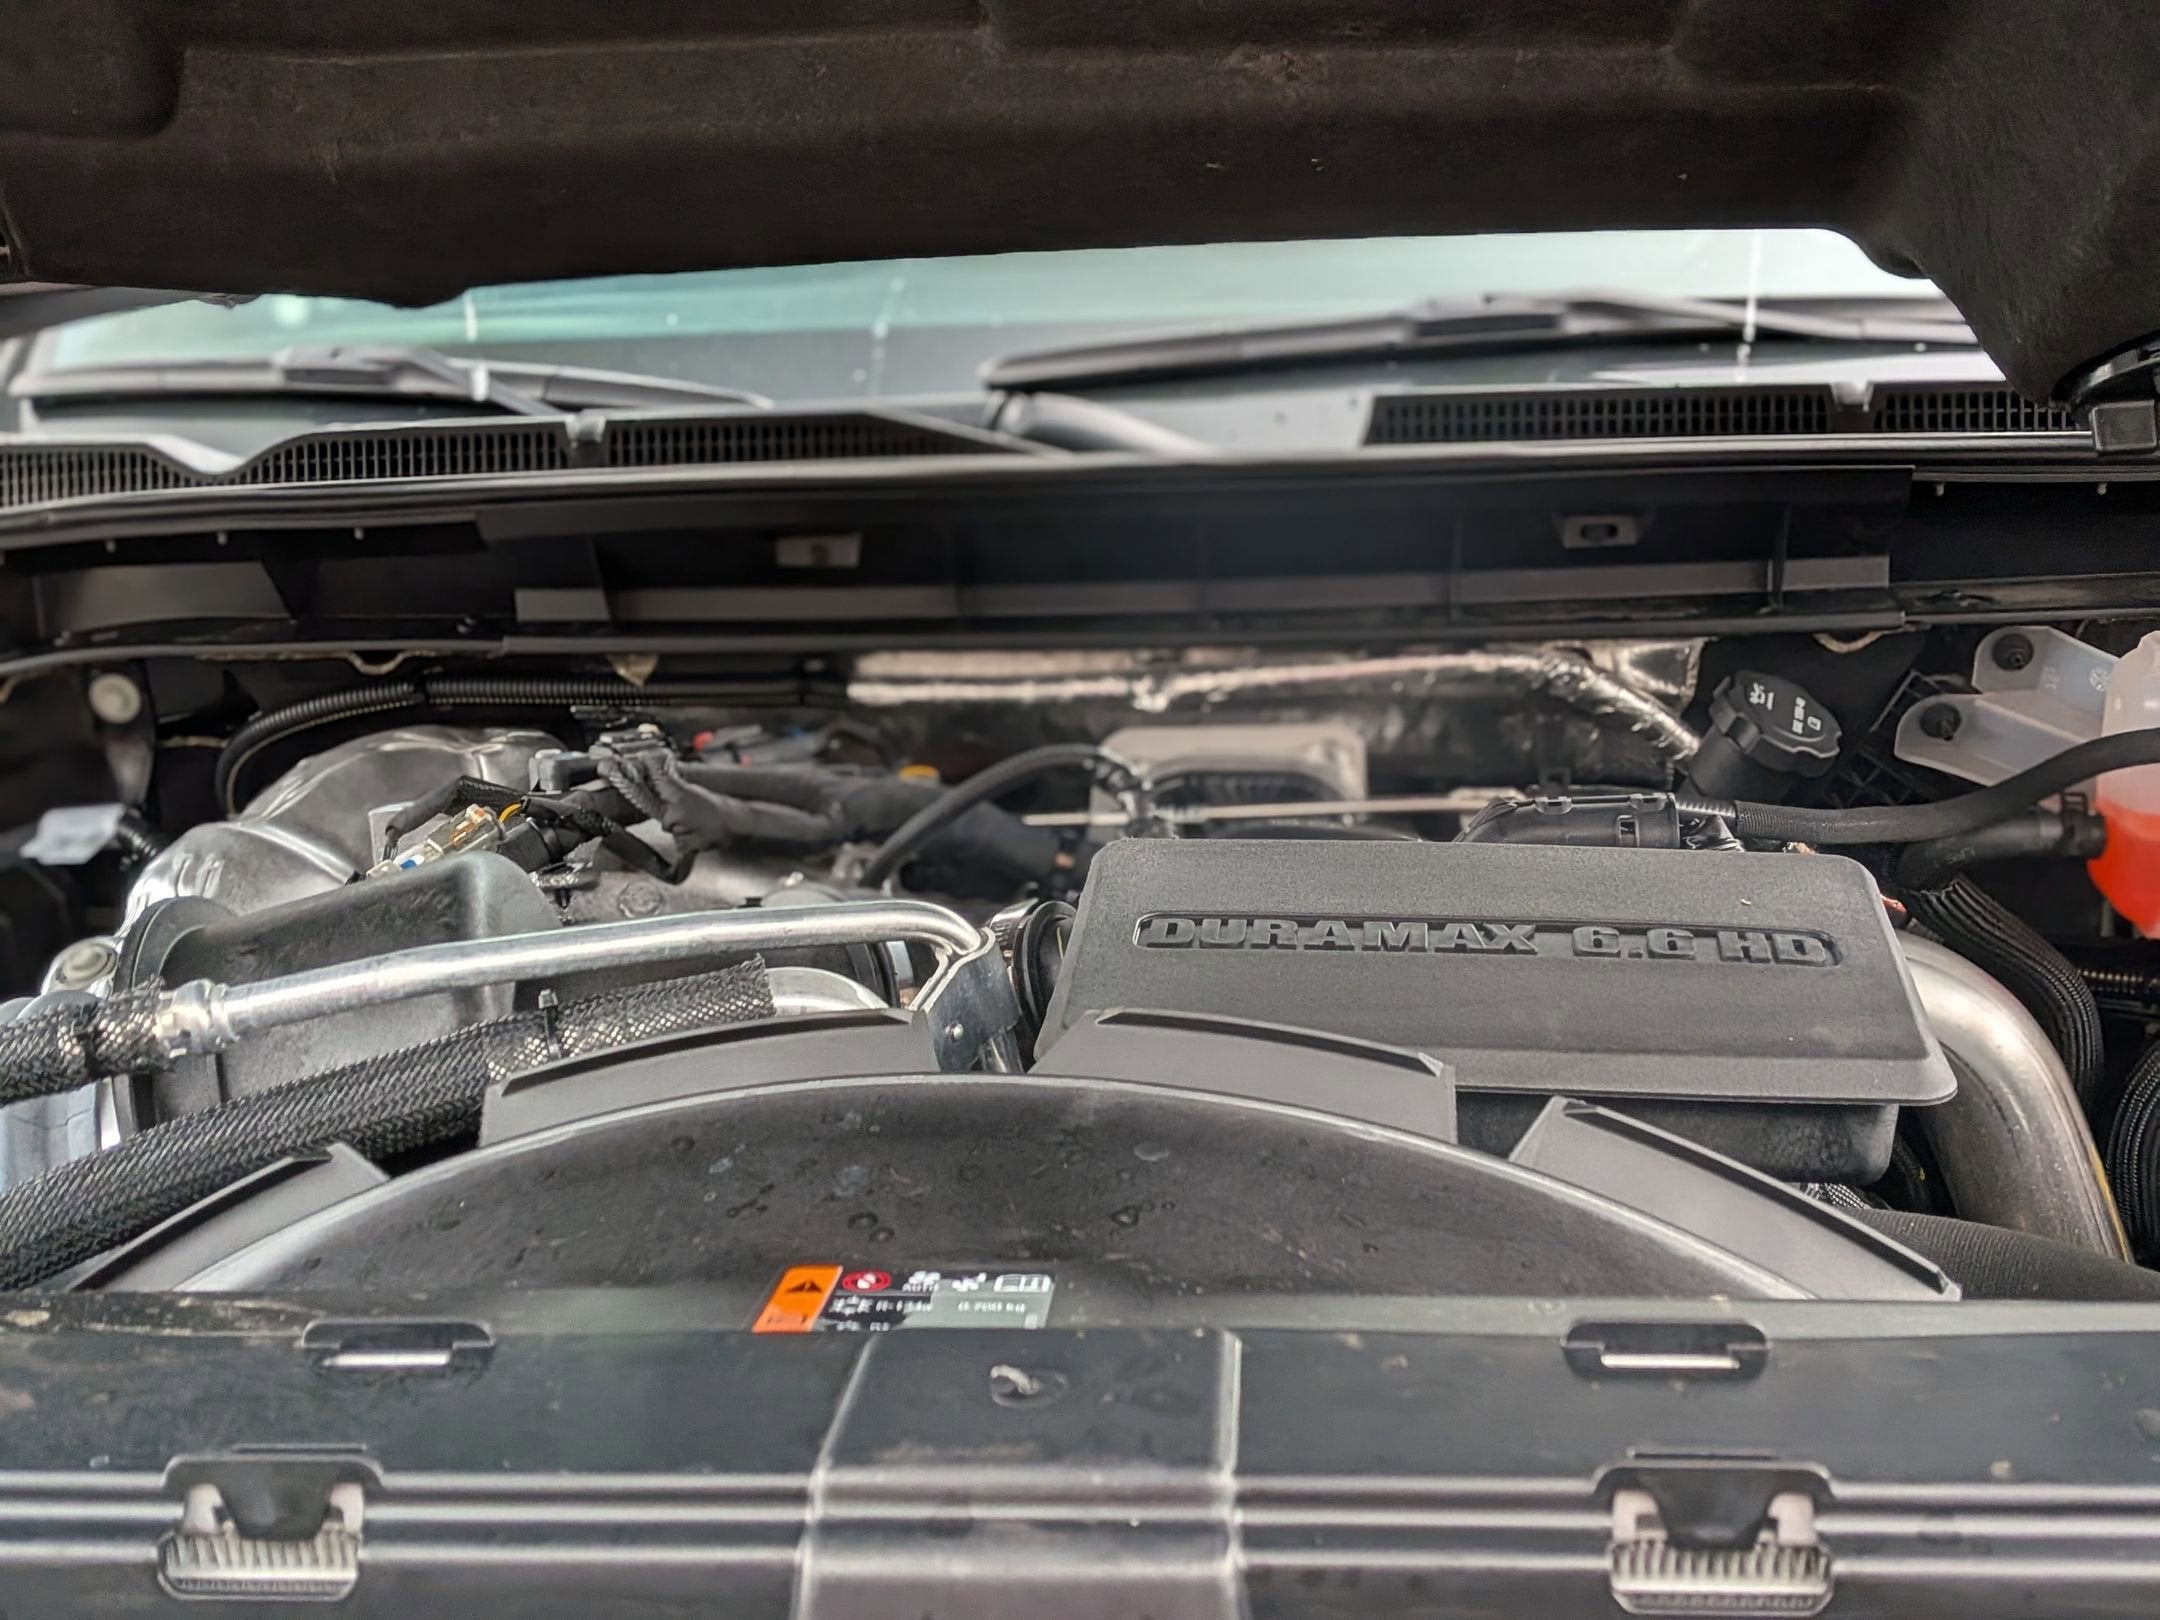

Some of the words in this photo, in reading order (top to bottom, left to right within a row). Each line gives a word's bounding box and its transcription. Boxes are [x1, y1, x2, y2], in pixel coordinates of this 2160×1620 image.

[1146, 917, 1539, 955] DURAMAX
[1572, 925, 1696, 960] 6.6
[1716, 930, 1828, 966] HD
